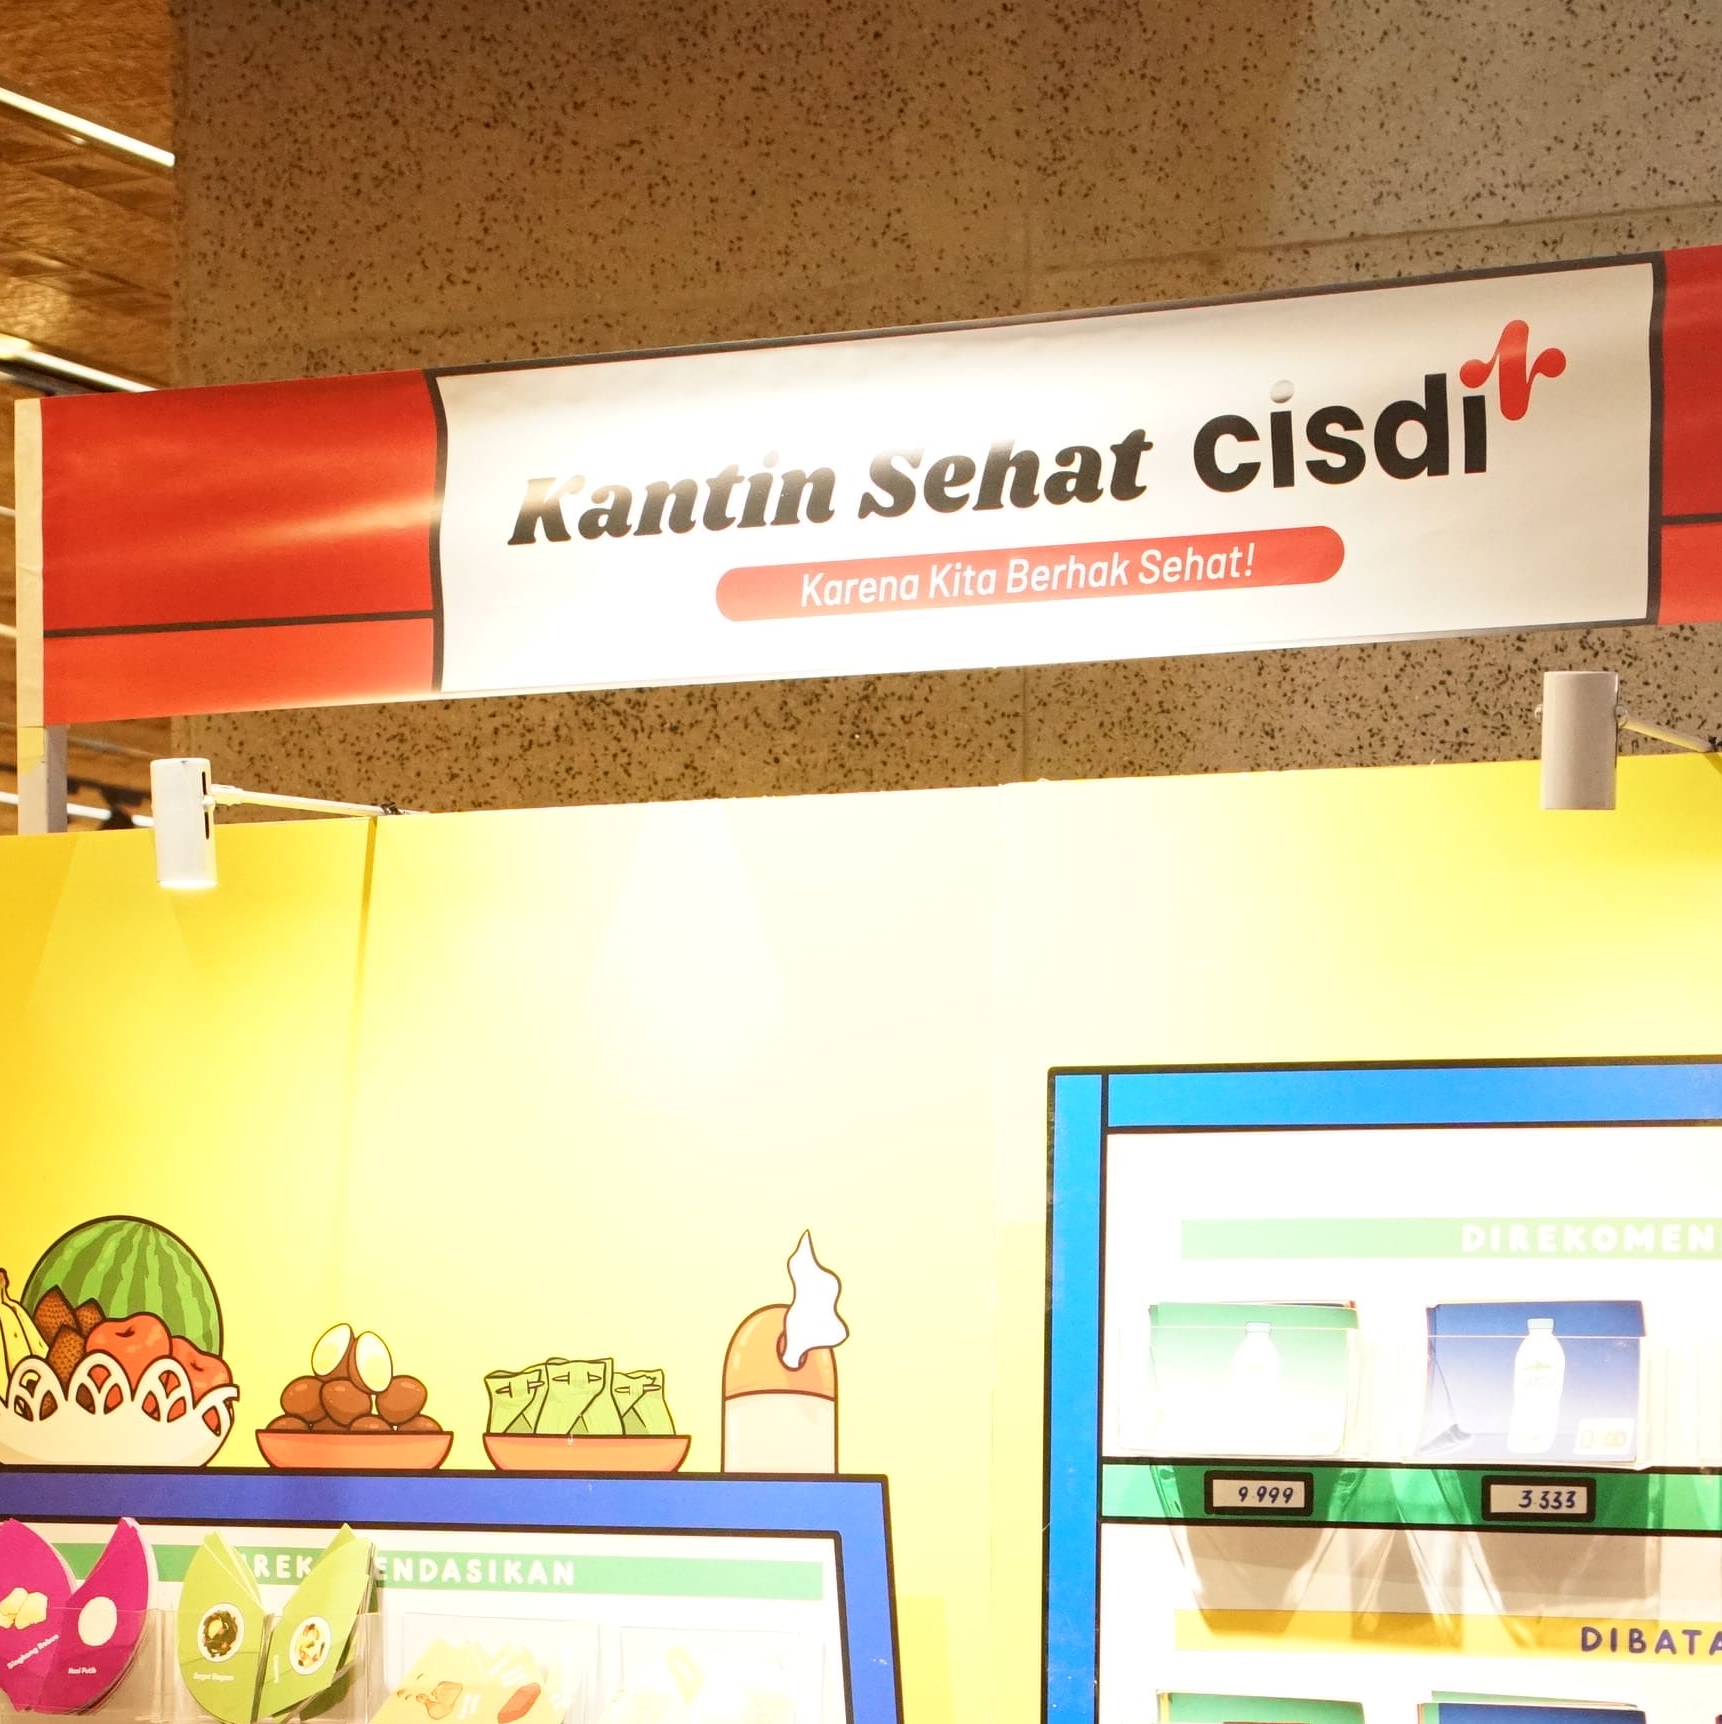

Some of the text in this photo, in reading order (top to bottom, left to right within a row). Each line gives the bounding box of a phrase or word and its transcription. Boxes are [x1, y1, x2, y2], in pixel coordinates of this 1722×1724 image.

[508, 362, 1489, 545] Kantin Sehat cisdi
[801, 542, 1255, 608] Karena Kita Berhak Sehat!
[1238, 1486, 1295, 1503] 9.999
[1518, 1489, 1577, 1509] 3.333
